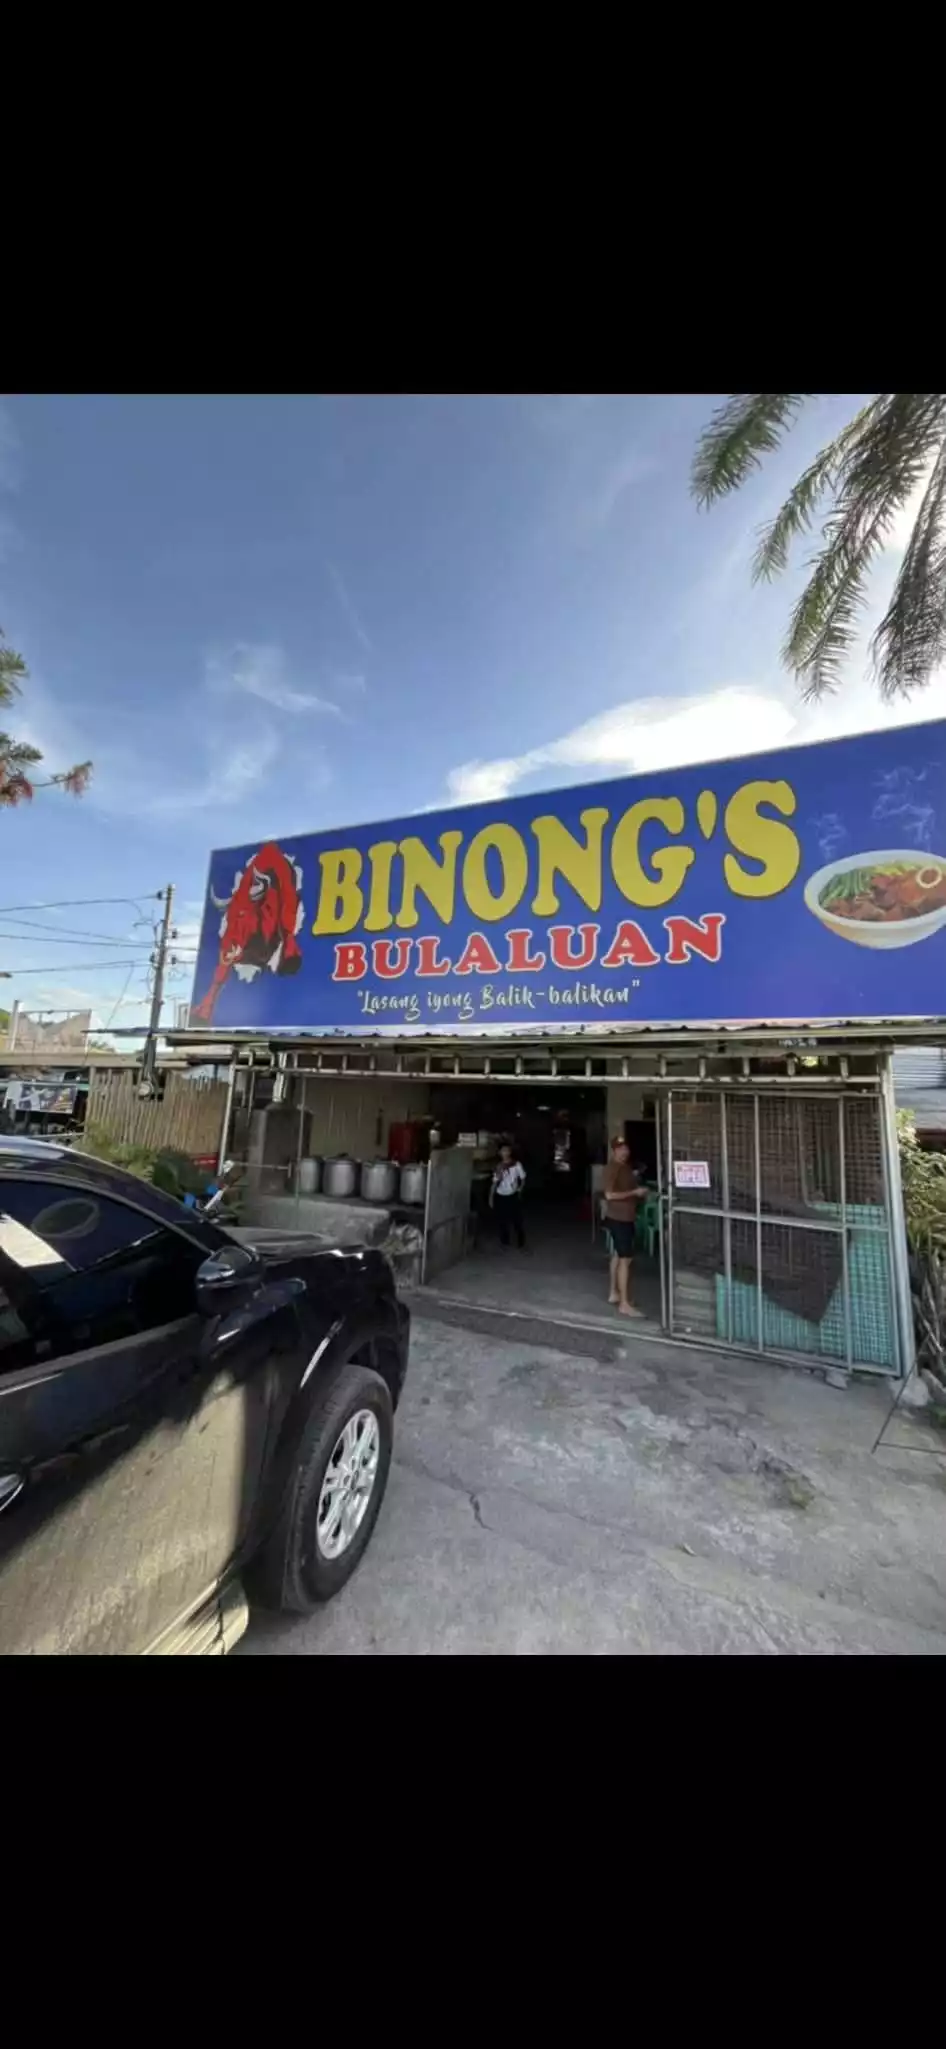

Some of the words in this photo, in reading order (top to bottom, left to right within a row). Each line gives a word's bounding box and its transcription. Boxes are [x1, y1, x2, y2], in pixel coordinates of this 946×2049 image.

[311, 779, 800, 936] BINONG'S
[332, 913, 726, 981] BULALUAN
[427, 991, 474, 1020] iyong
